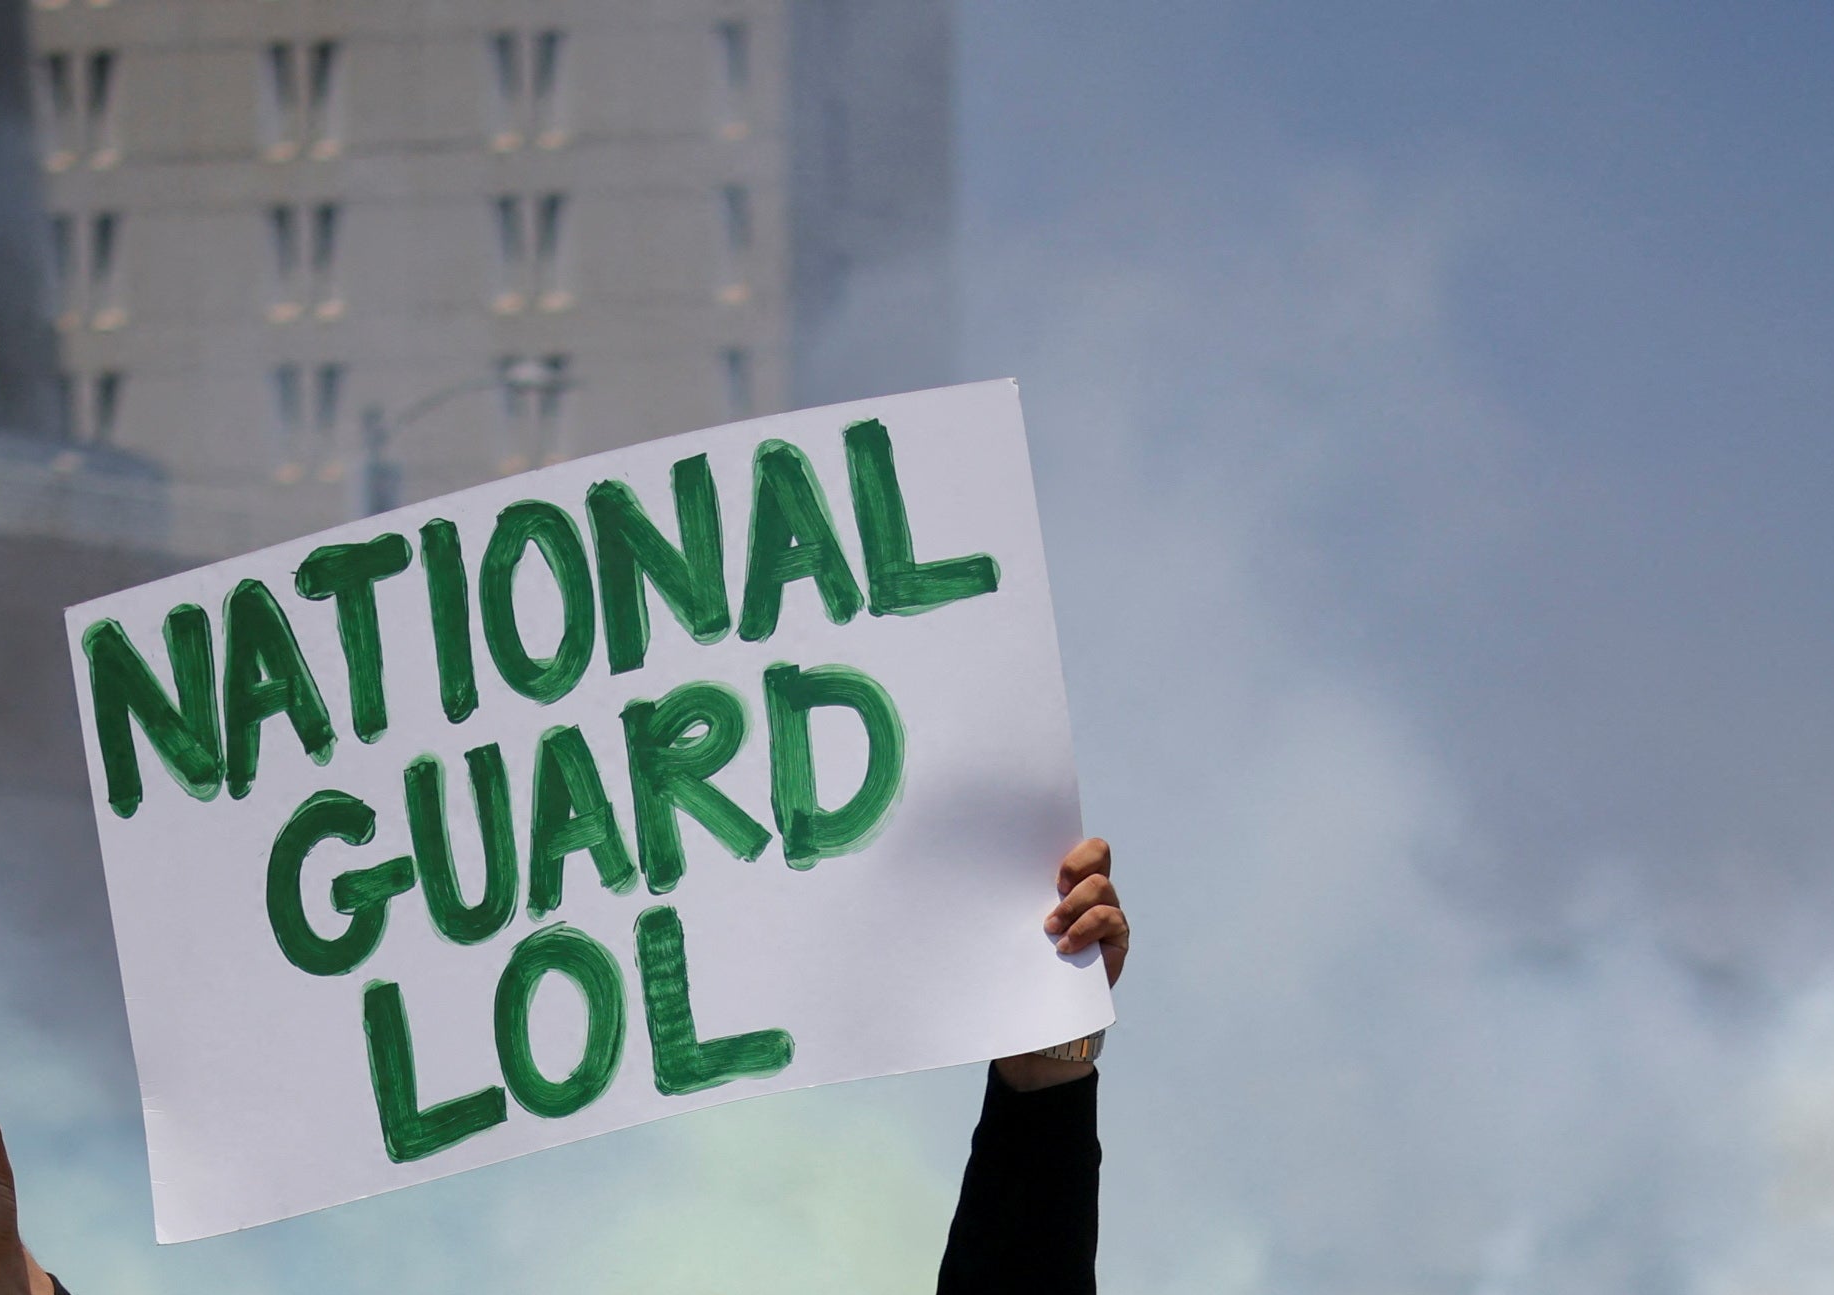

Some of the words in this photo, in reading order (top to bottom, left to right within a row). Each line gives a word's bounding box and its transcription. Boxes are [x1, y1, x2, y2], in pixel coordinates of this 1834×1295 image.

[81, 418, 1003, 819] NATIONAL
[265, 660, 909, 977] GUARD
[361, 903, 797, 1165] LOL
